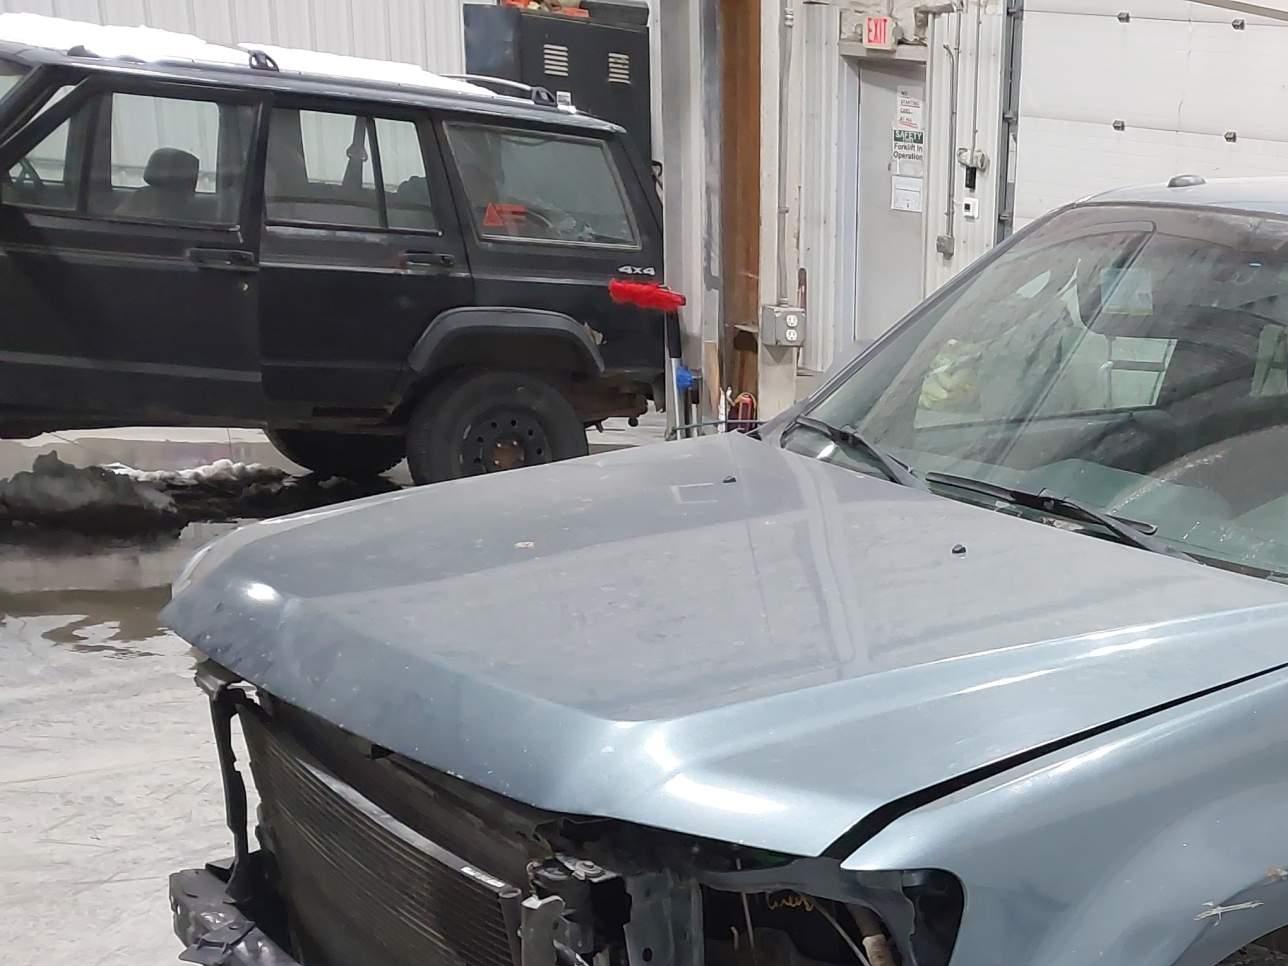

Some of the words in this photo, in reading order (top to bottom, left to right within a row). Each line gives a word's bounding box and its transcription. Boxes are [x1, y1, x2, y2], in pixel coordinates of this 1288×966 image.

[867, 17, 888, 44] EXIT
[895, 130, 922, 140] SAFETY
[894, 142, 915, 151] Forklift
[893, 150, 923, 160] Operation
